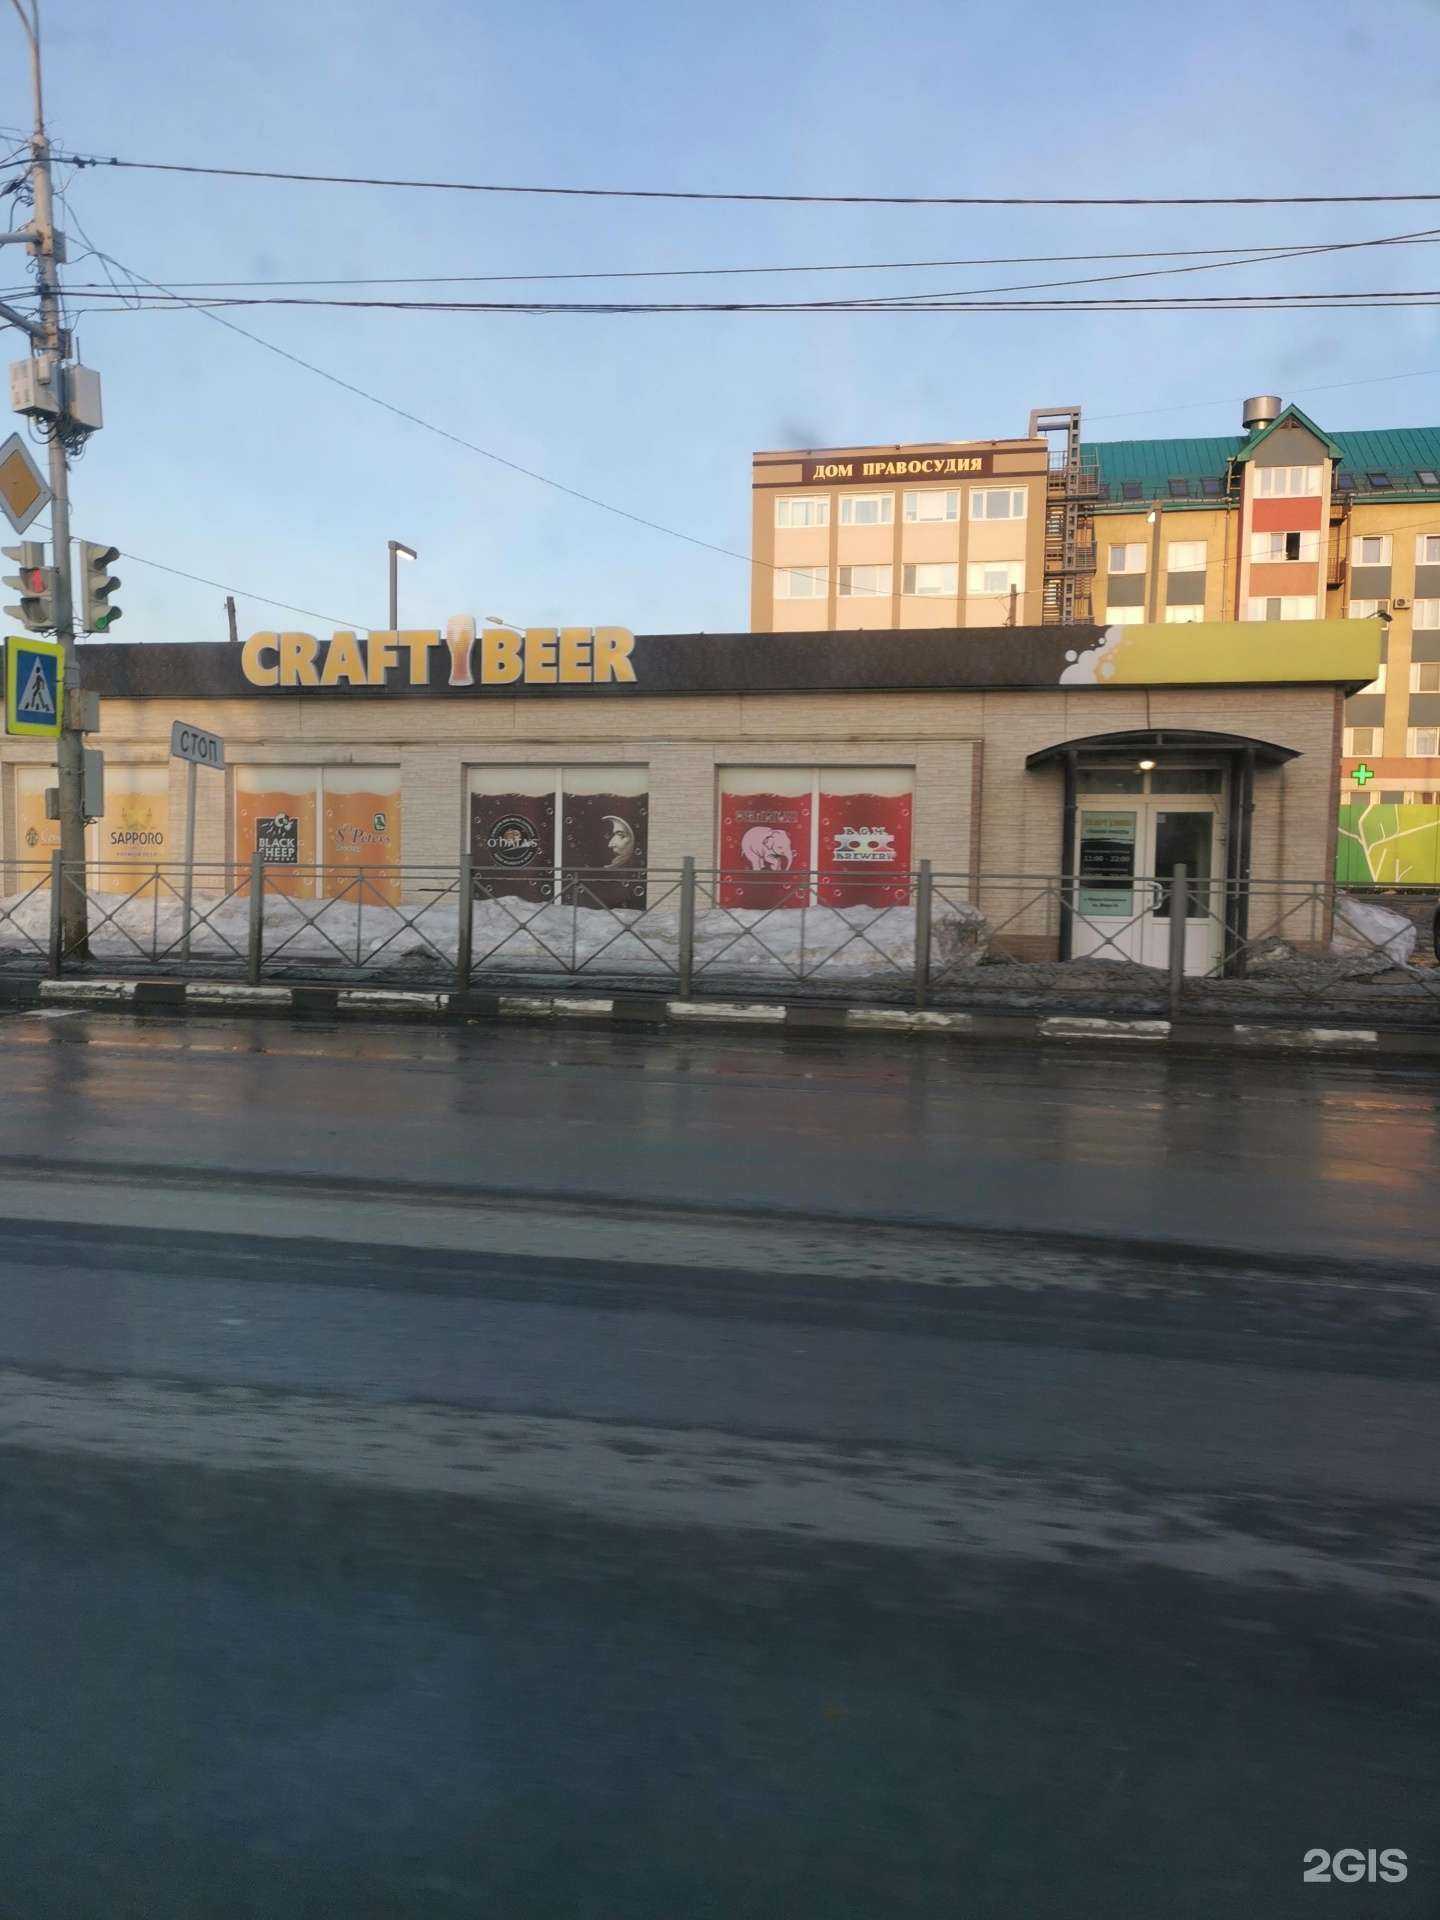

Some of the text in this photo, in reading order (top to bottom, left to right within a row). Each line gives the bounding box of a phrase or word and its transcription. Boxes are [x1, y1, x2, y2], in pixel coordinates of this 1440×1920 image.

[812, 458, 983, 480] ДОМ ПРАВОСУДИЯ
[241, 626, 638, 687] CRAFT BEER
[181, 730, 218, 762] СТОП
[110, 831, 164, 846] SAPPORO
[259, 837, 296, 848] BLACK
